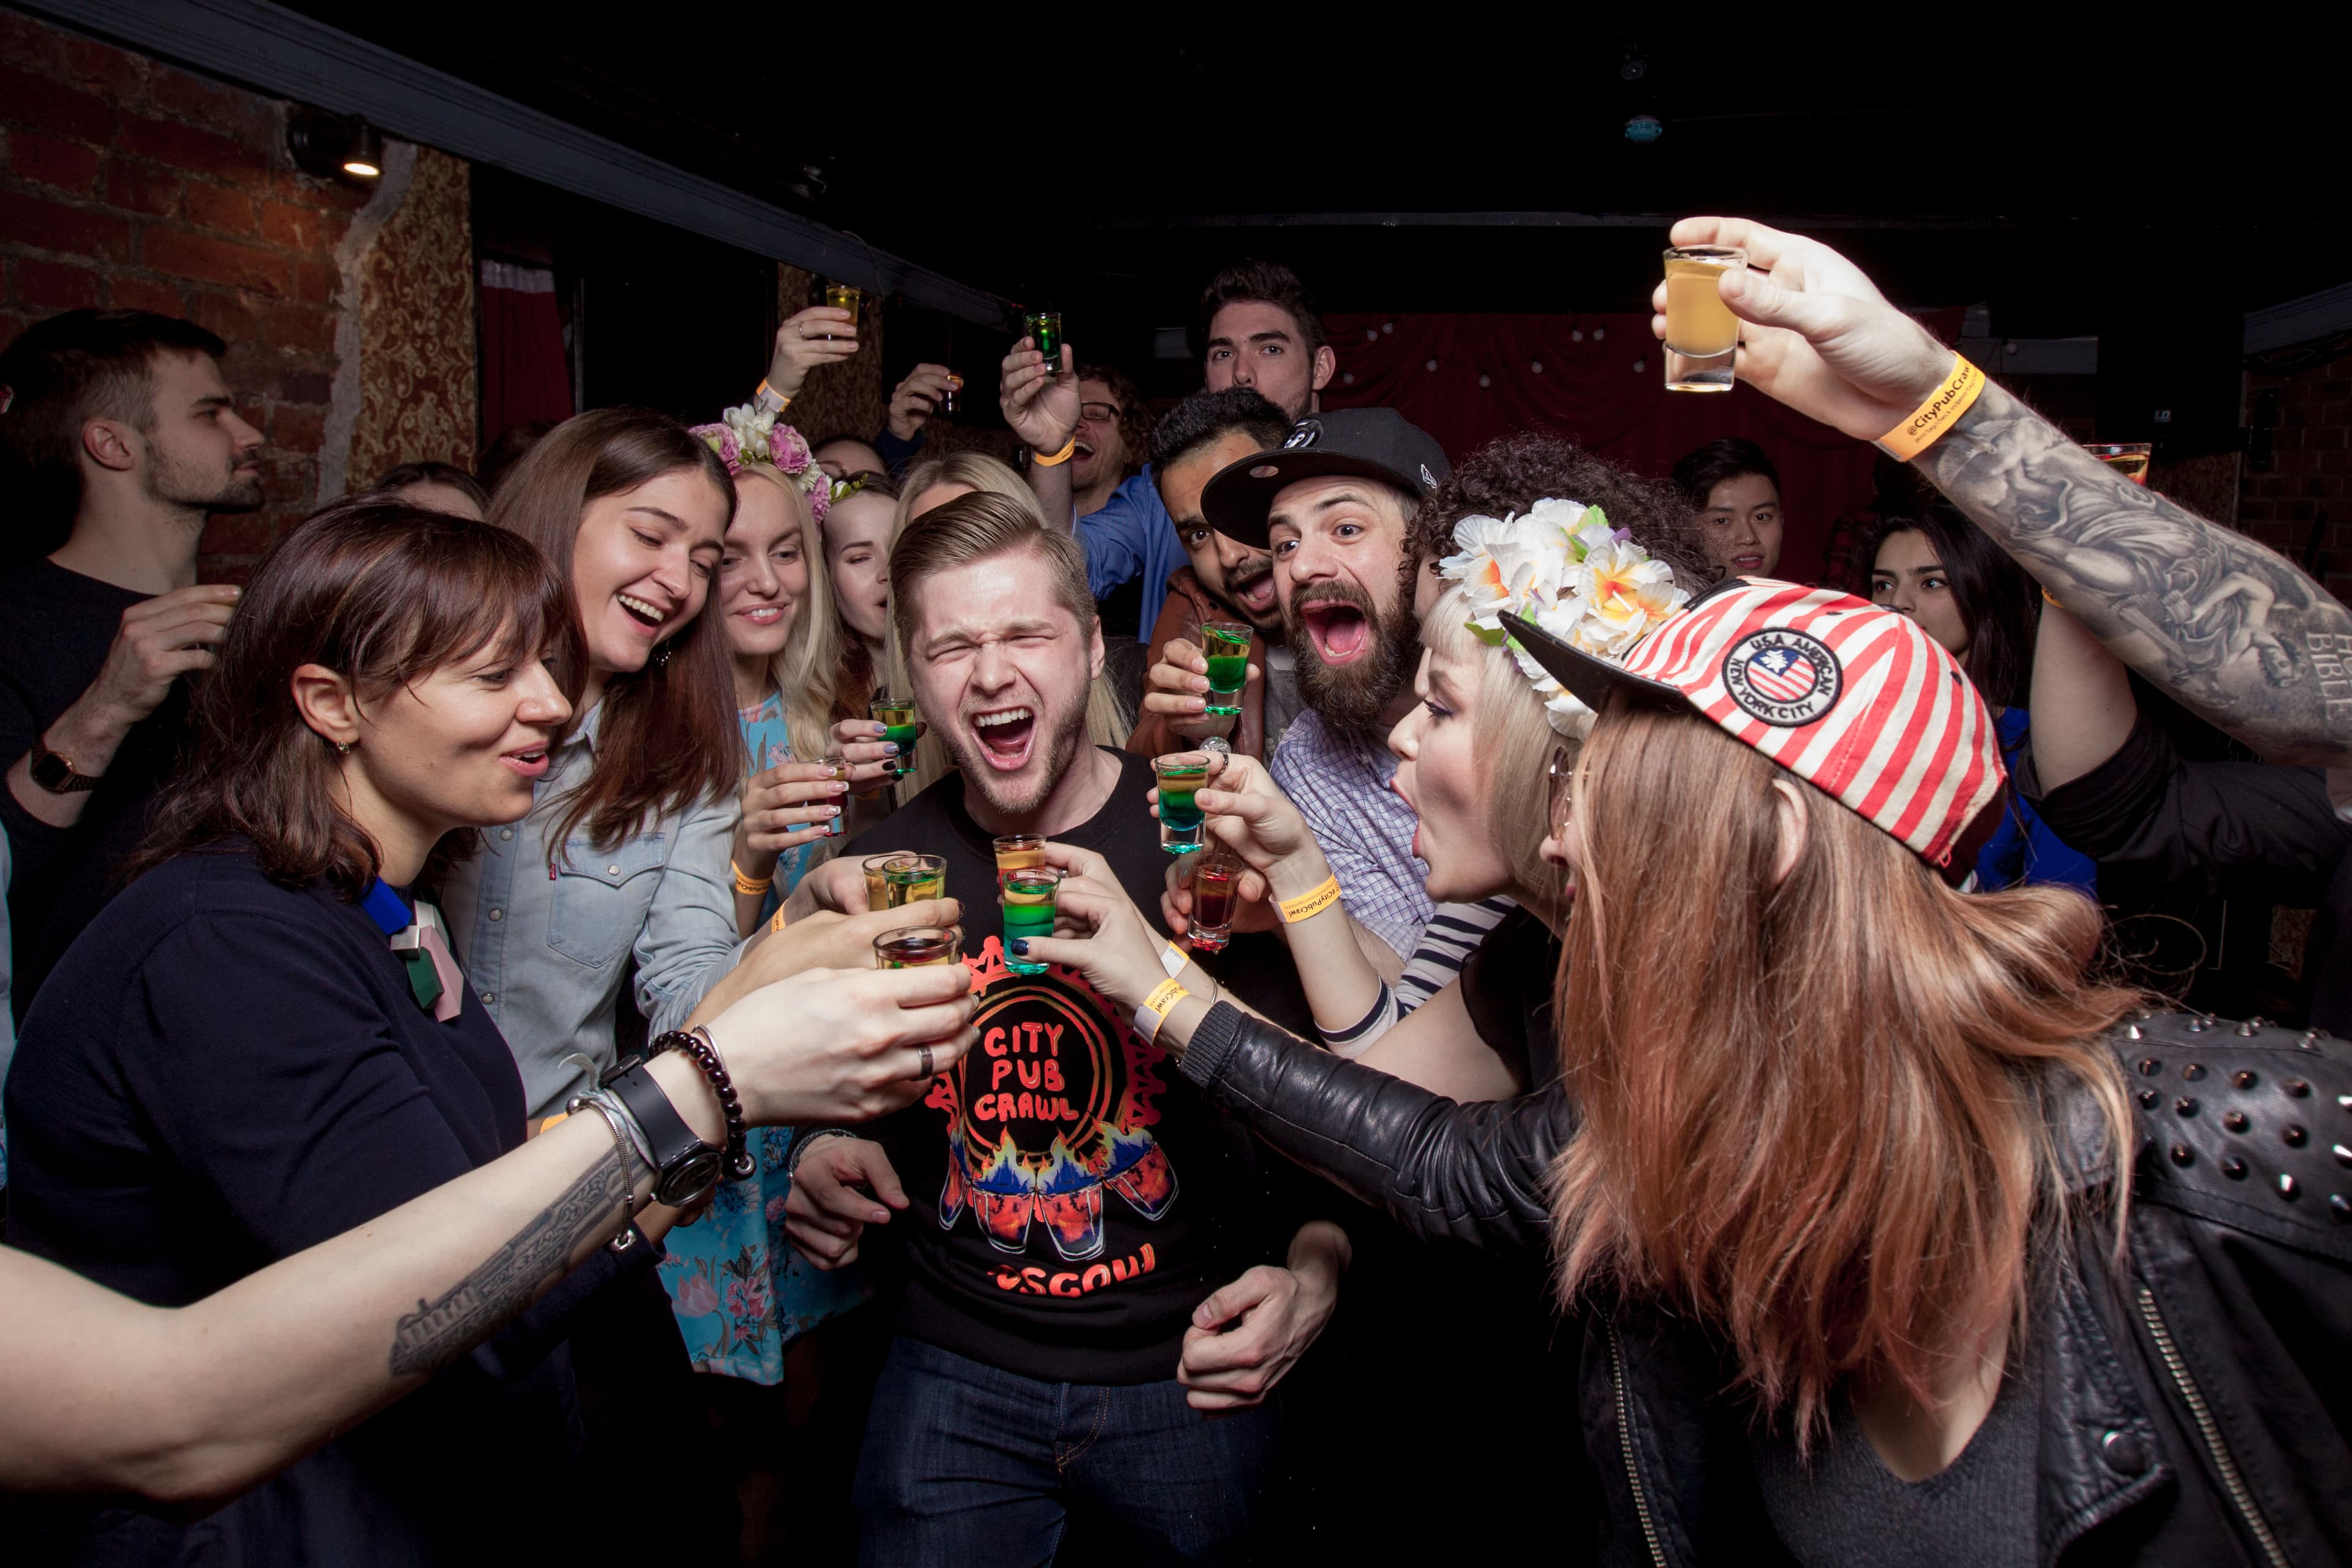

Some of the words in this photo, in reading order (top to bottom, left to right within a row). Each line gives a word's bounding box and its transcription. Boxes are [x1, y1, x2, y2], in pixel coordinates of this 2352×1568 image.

[1751, 634, 1784, 650] USA
[1730, 658, 1744, 687] NEW
[1738, 686, 1774, 718] YORK
[1777, 701, 1815, 719] CITY
[2307, 632, 2352, 720] BIBLE
[984, 1022, 1064, 1057] CITY
[991, 1058, 1065, 1091] PUB
[973, 1093, 1080, 1121] CRAWL
[987, 1242, 1156, 1298] OSCOW
